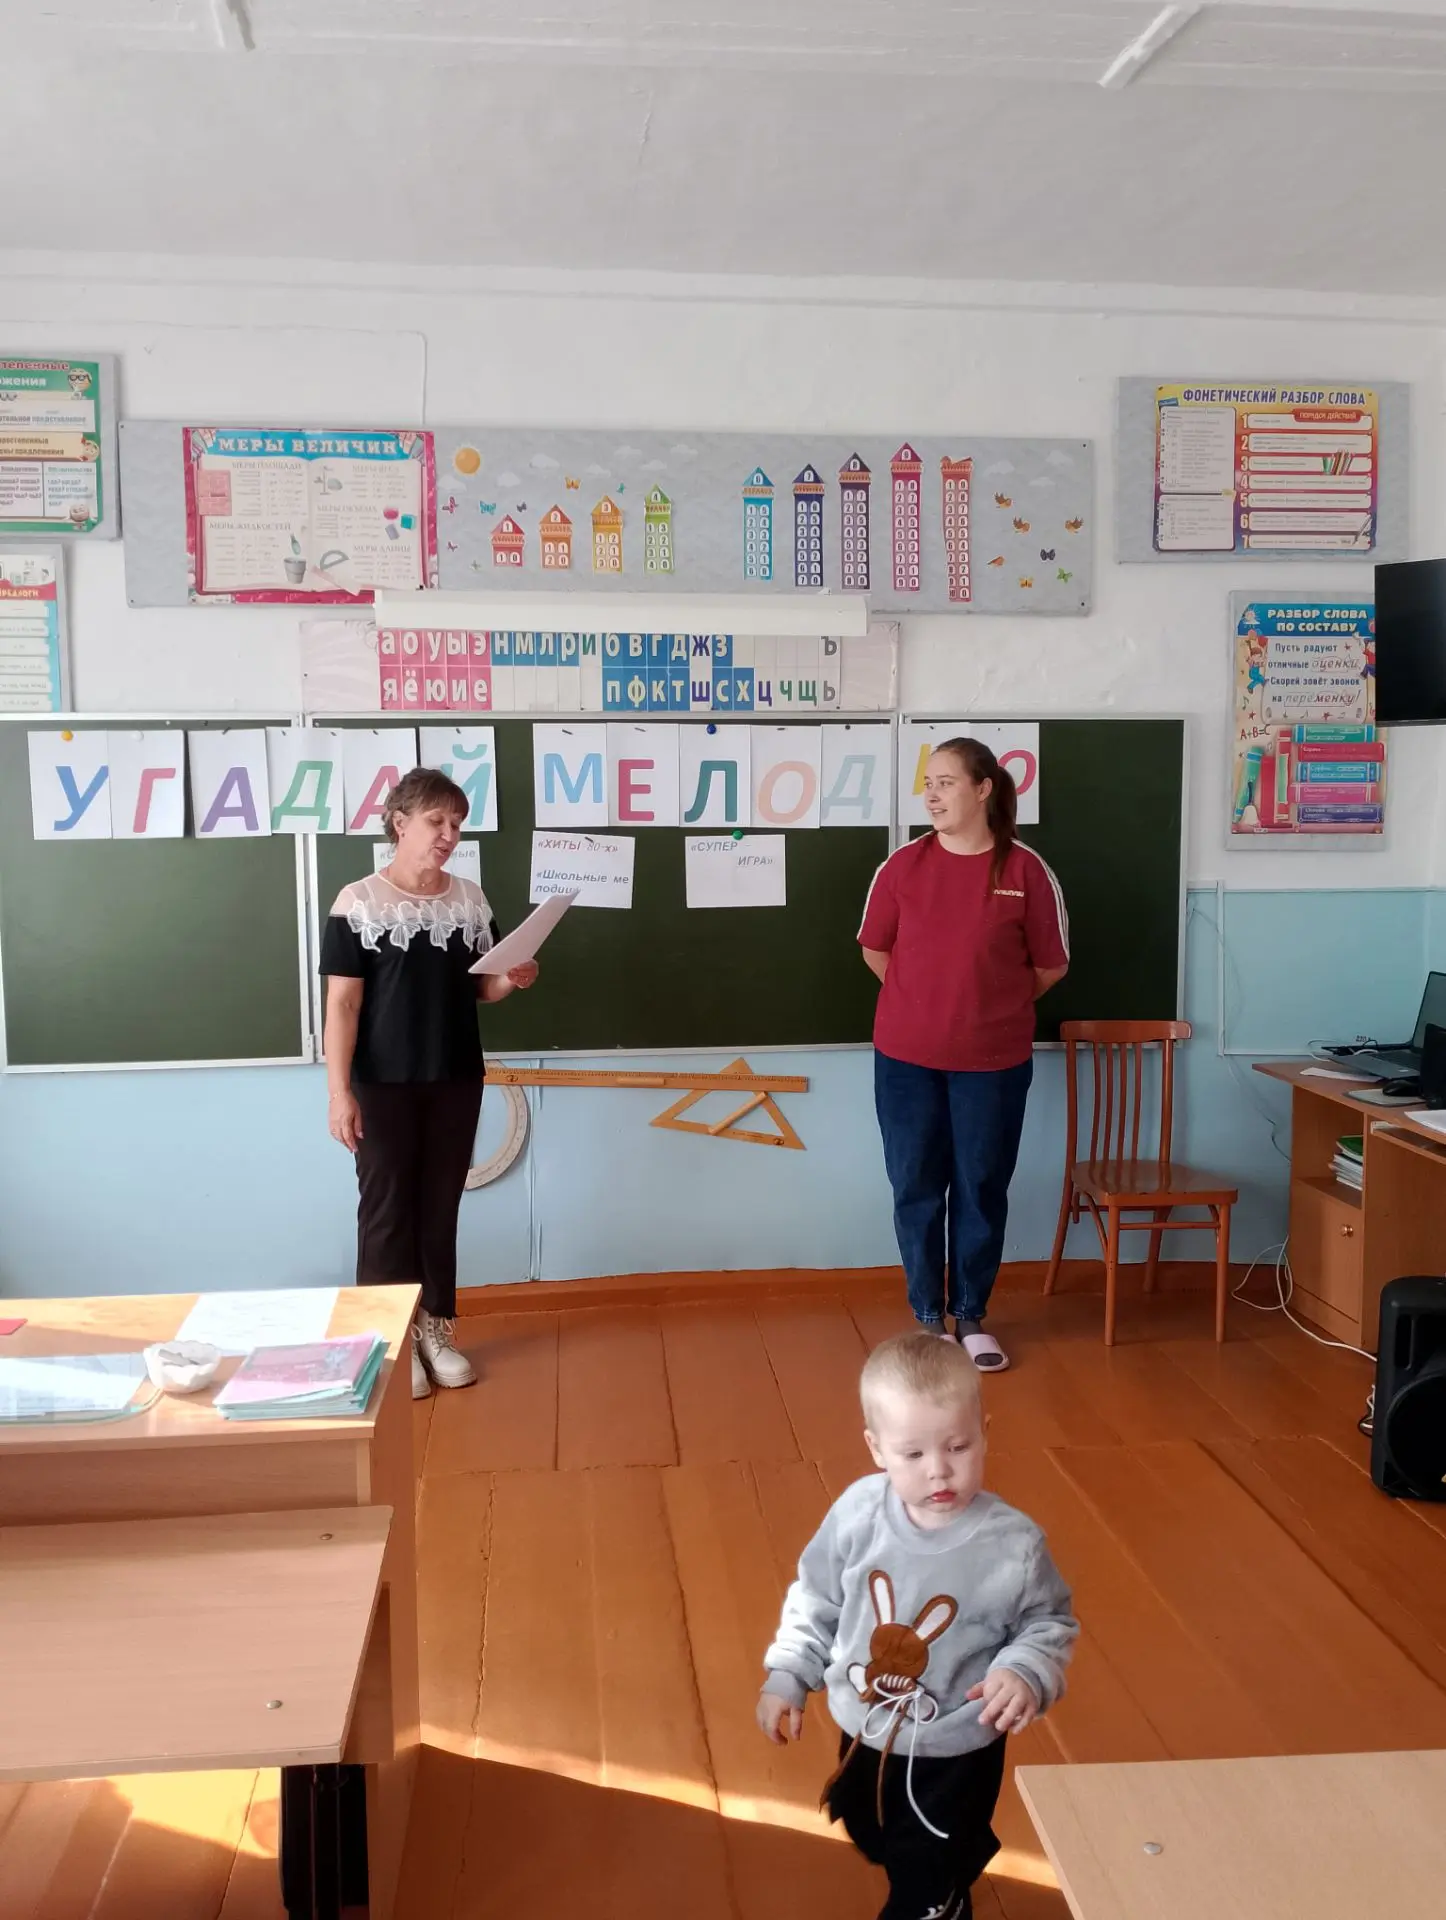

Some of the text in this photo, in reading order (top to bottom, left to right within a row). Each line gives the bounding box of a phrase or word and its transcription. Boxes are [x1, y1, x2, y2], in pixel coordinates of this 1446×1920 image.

[0, 377, 46, 386] жения
[1184, 388, 1365, 405] ФОНЕТИЧЕСКИЙ РАЗБОР СЛОВА
[1241, 413, 1247, 428] 1
[217, 438, 396, 454] МЕРЫ ВЕЛИЧИН
[1241, 435, 1248, 450] 2
[1241, 456, 1248, 470] 3
[1241, 475, 1248, 489] 4
[1240, 493, 1248, 507] 5
[1241, 514, 1248, 528] 6
[1242, 535, 1249, 548] 7
[1268, 609, 1367, 619] РАЗБОР СЛОВА
[1277, 622, 1357, 632] ПО СОСТАВУ
[1275, 643, 1338, 654] Пусть радуют
[1271, 677, 1300, 687] Скорей
[1303, 678, 1328, 686] зовёт
[538, 839, 580, 851] «ХИТЫ
[691, 841, 737, 852] «СУПЕР
[738, 856, 773, 866] ИГРА»
[537, 869, 629, 884] «Школьные ме
